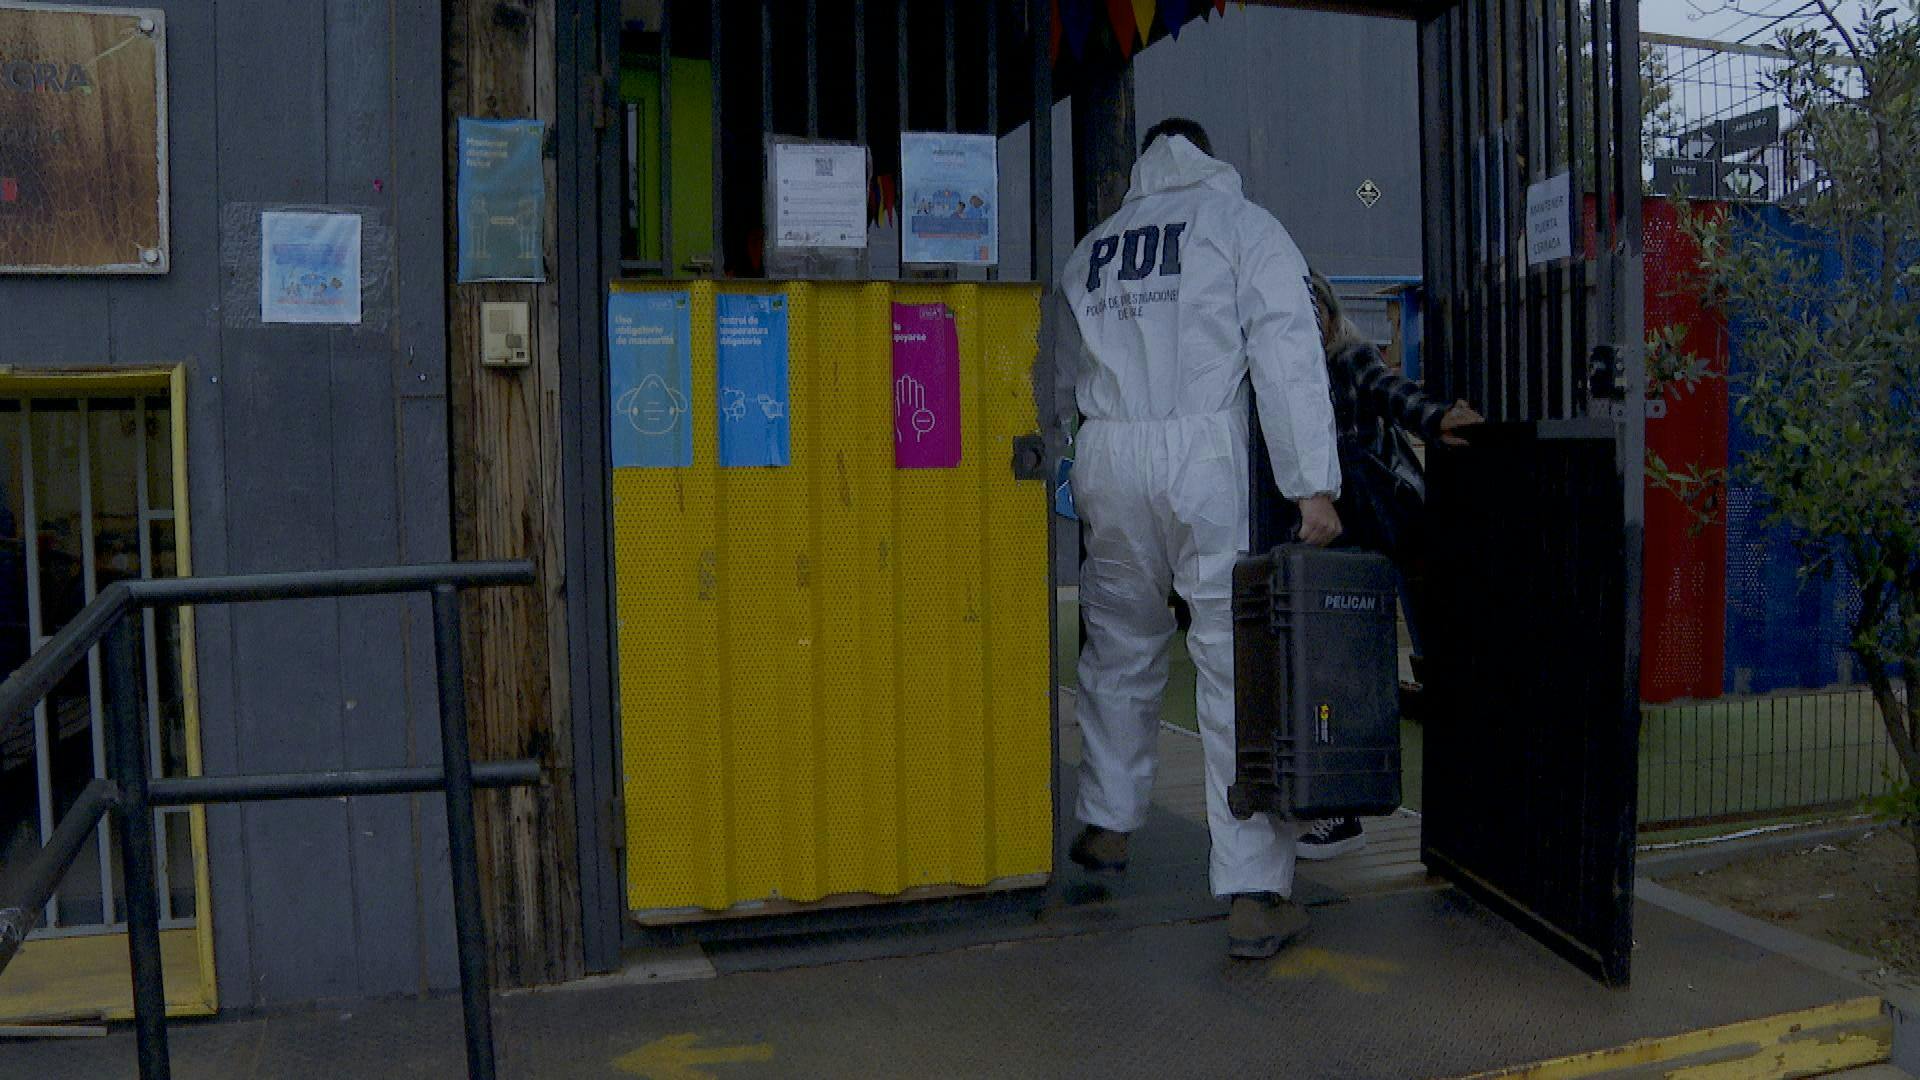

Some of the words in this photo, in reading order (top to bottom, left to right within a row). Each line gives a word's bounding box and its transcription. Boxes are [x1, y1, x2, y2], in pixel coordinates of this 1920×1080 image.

[1086, 221, 1187, 292] PDI
[720, 315, 747, 325] ontrol
[747, 315, 758, 325] de
[1325, 595, 1376, 609] PELICAN
